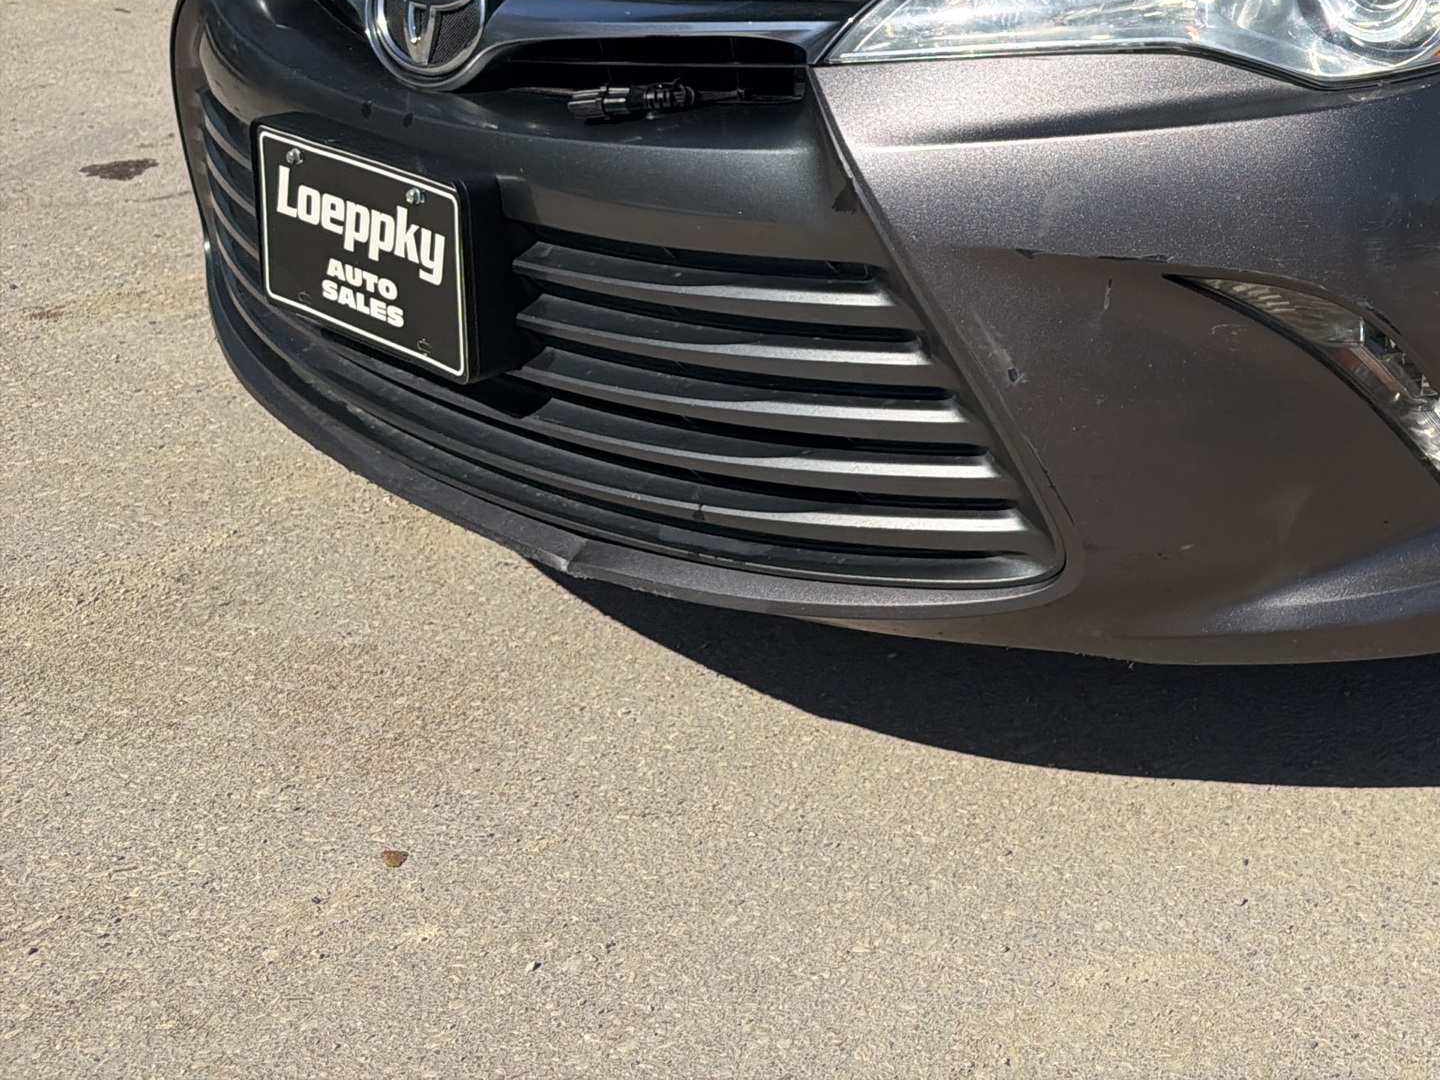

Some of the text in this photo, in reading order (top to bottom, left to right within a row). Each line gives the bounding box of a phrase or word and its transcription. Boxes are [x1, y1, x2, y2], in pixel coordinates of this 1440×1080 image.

[276, 165, 446, 286] Loeppky
[326, 258, 398, 301] AUTO
[321, 280, 404, 328] SALES
